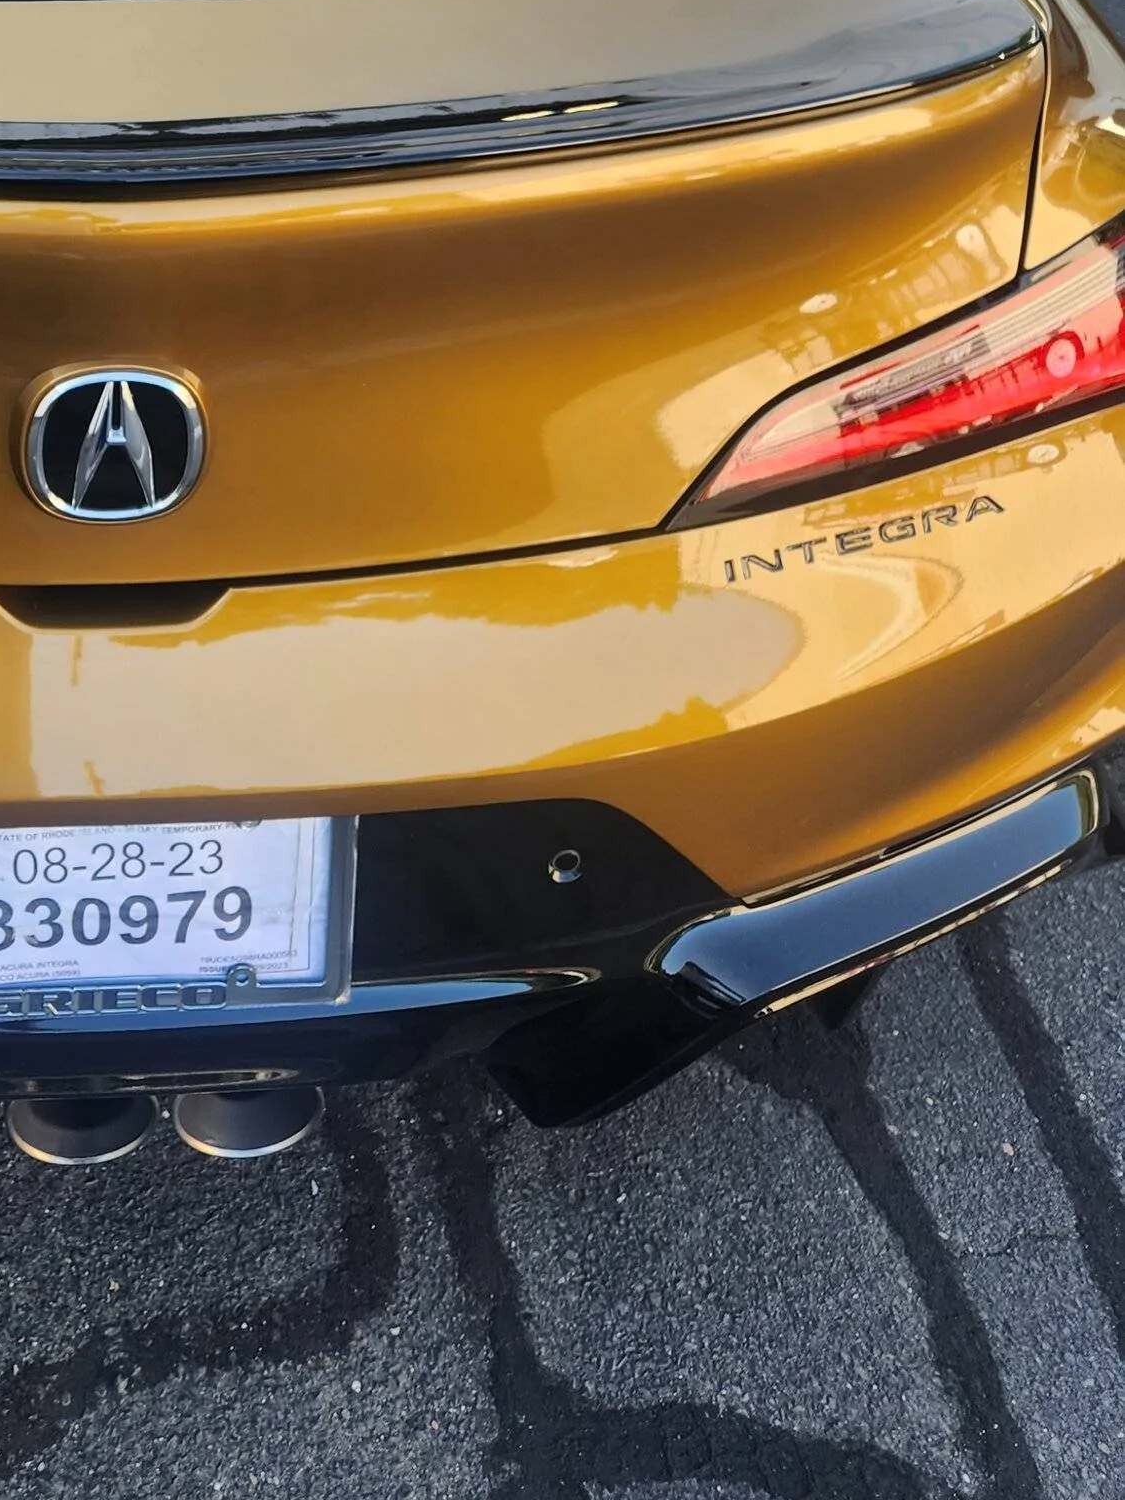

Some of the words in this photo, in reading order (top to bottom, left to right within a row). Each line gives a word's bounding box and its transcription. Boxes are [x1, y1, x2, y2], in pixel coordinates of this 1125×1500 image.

[724, 495, 1006, 583] INTEGRA
[13, 839, 223, 885] 08-28-23
[0, 962, 33, 972] ACURA
[36, 959, 79, 969] INTEGRA
[17, 970, 50, 981] ACURA
